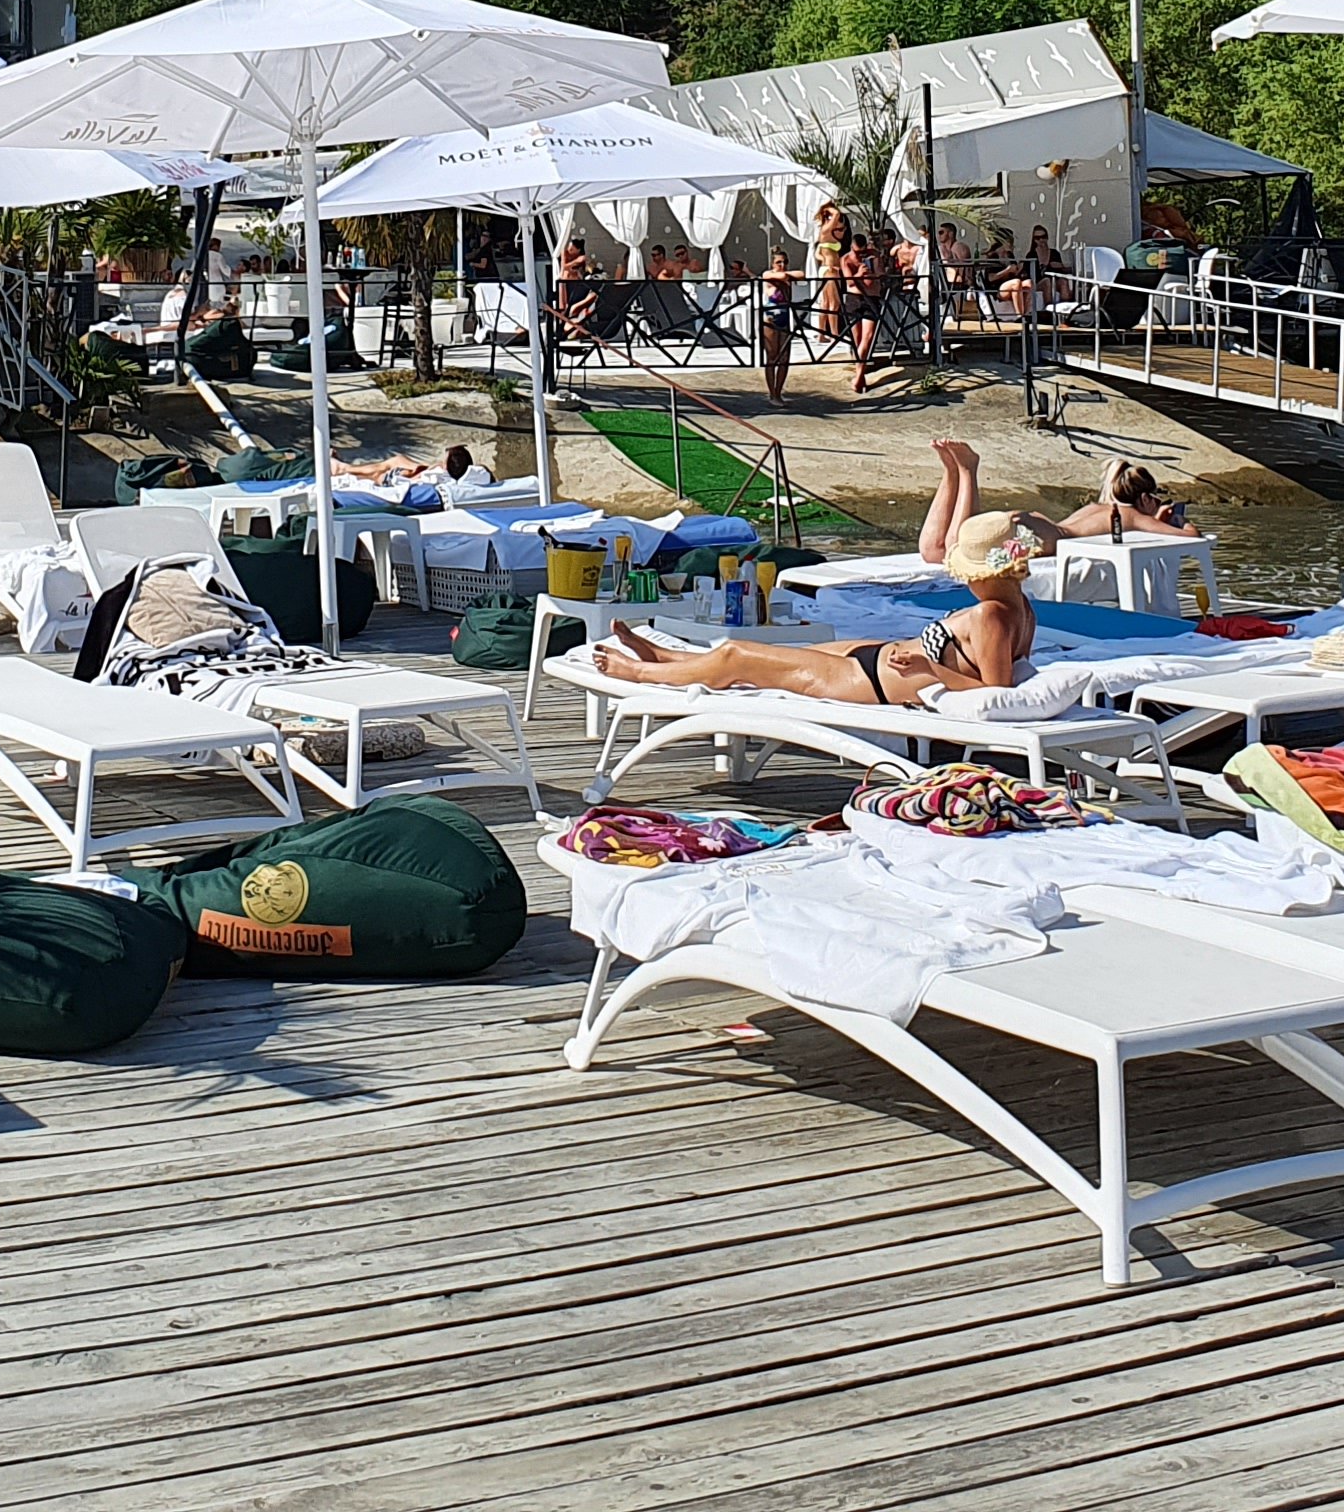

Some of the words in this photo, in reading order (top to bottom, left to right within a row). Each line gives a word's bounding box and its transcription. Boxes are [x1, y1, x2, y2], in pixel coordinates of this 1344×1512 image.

[513, 144, 526, 153] &
[532, 136, 654, 149] CHANDON
[224, 175, 248, 194] ella
